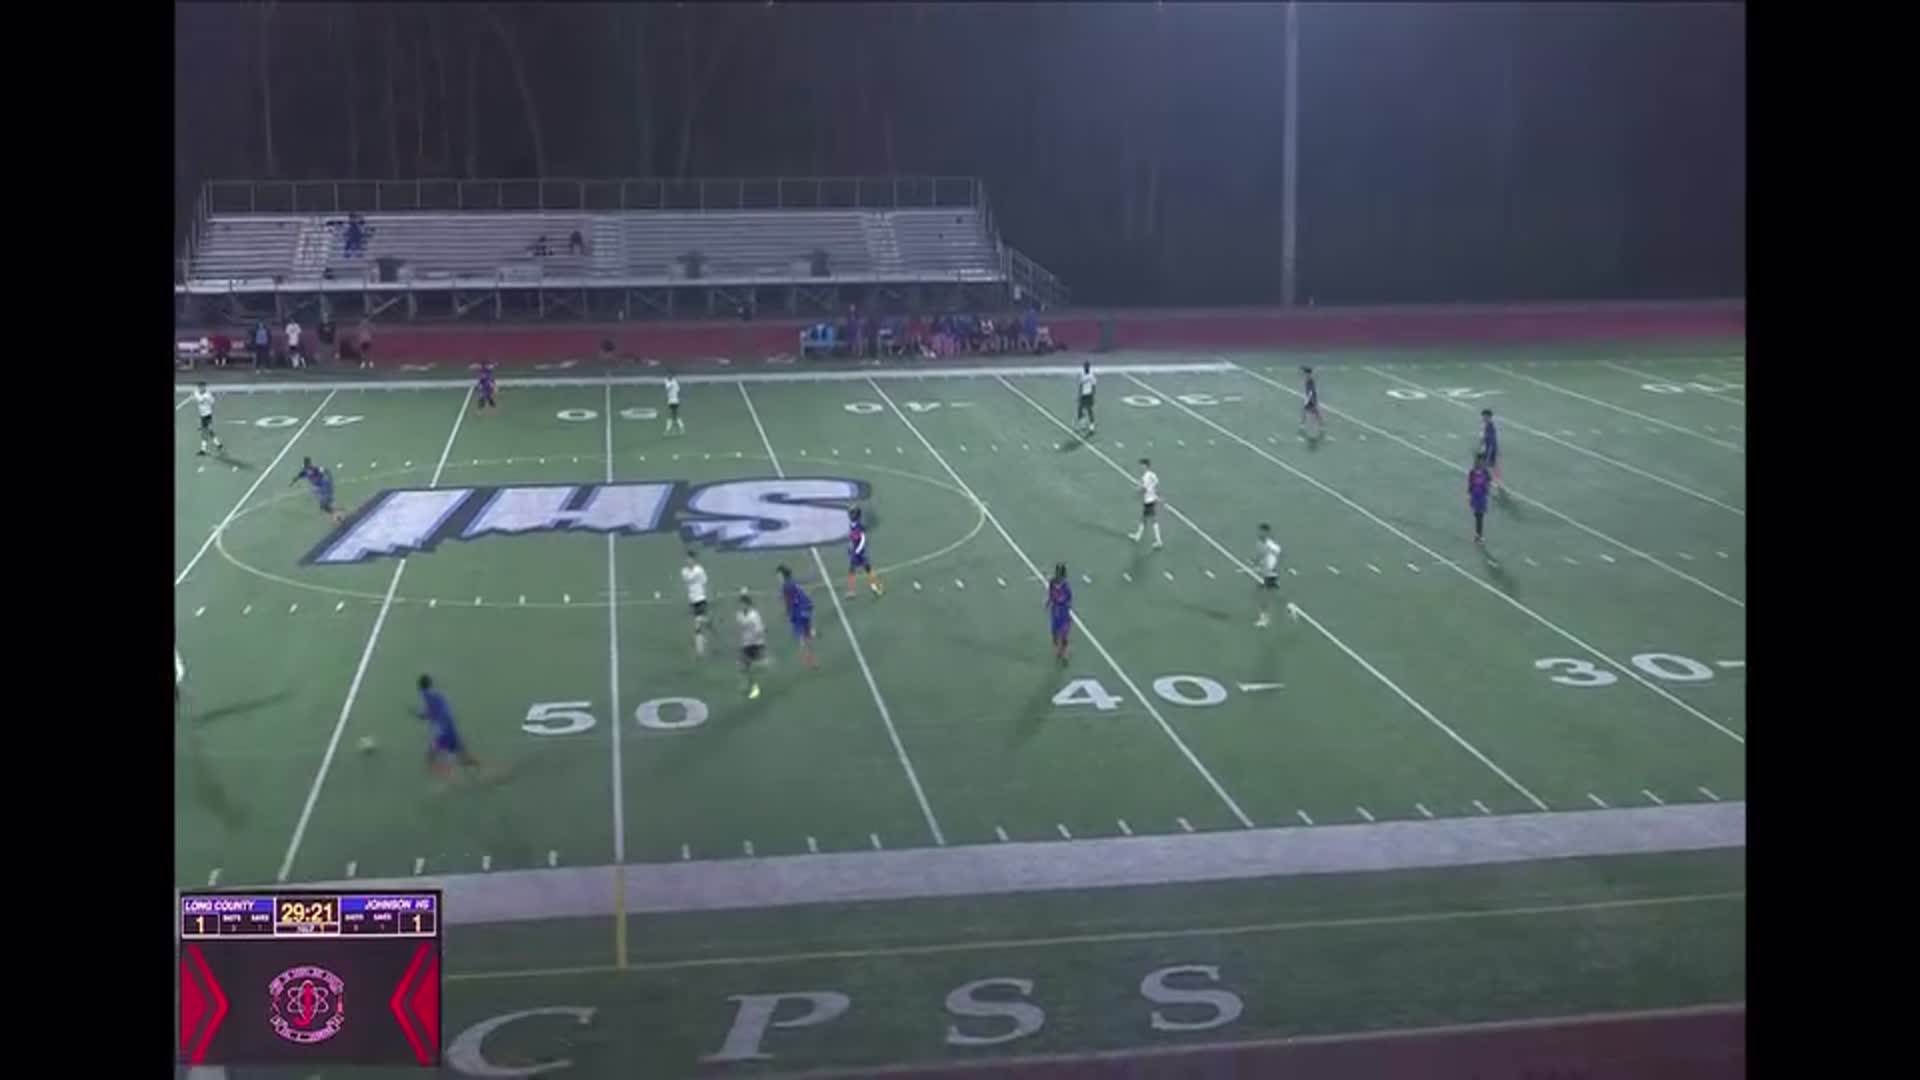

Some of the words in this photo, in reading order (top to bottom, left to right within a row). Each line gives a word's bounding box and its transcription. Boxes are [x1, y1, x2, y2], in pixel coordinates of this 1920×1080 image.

[1535, 653, 1714, 686] 30
[1052, 675, 1228, 709] 40
[521, 696, 709, 735] 50
